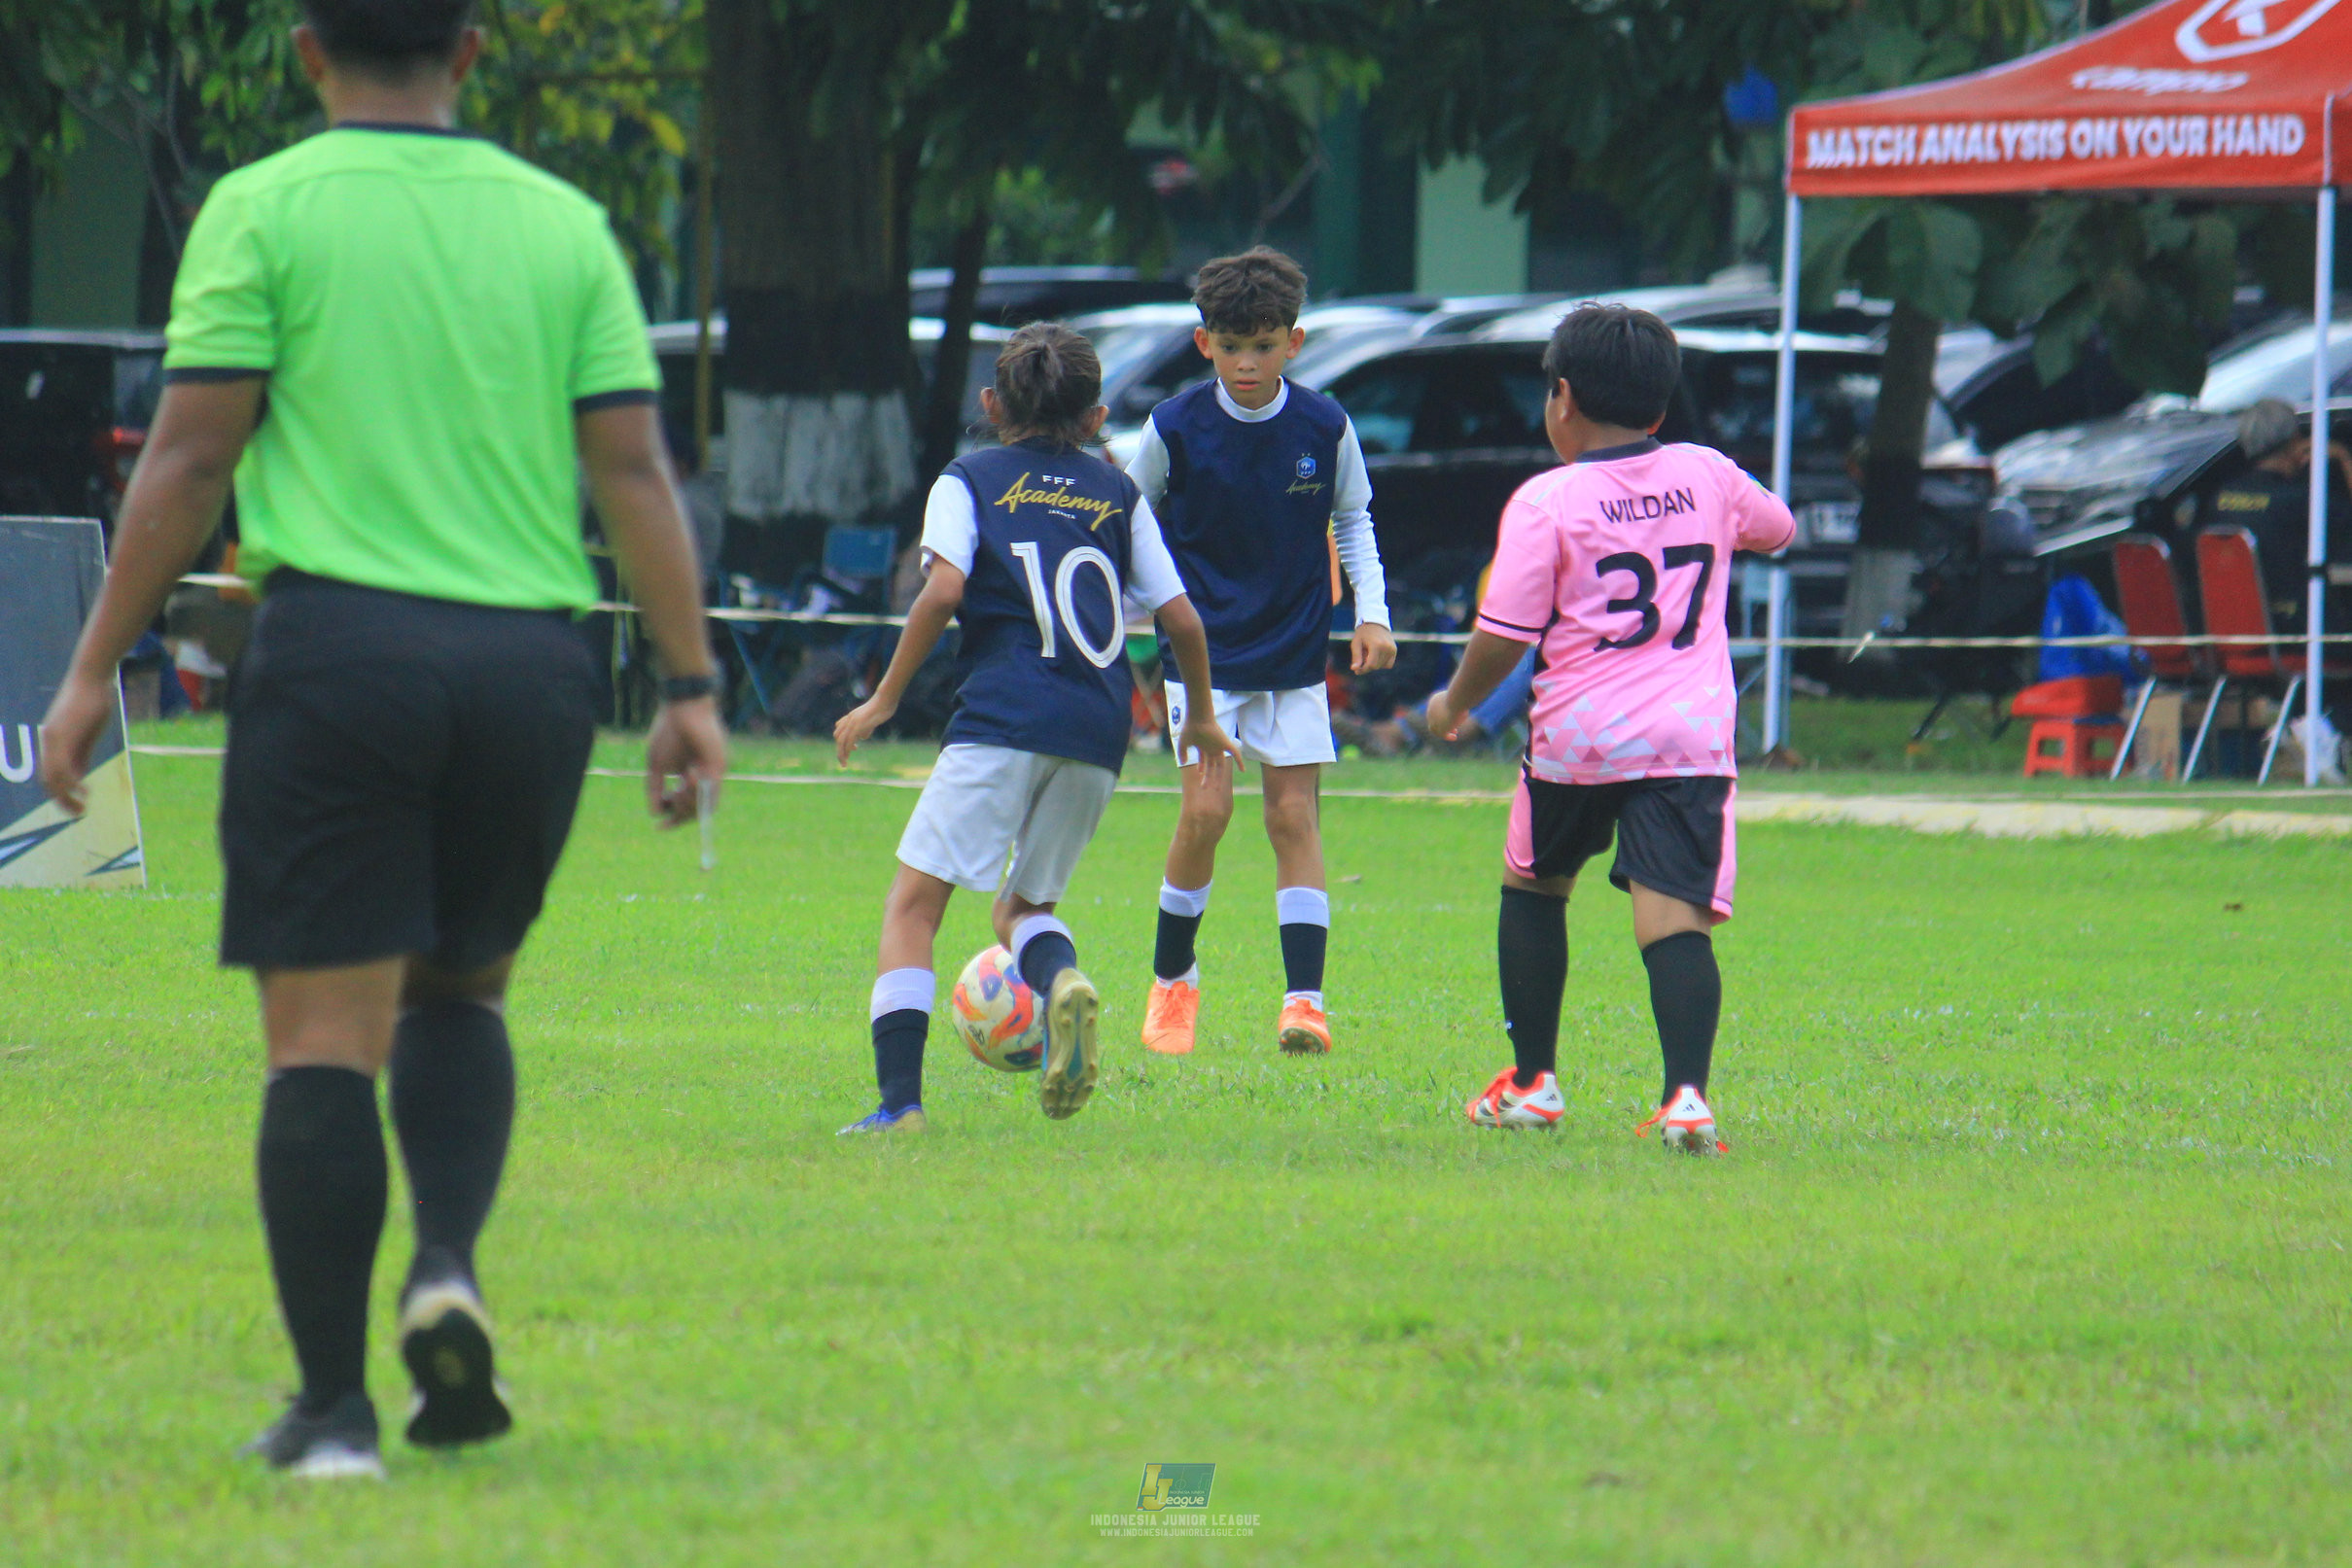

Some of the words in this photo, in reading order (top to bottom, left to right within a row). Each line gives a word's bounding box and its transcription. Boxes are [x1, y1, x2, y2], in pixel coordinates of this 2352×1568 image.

[1807, 125, 1918, 169] MATCH
[1917, 119, 2067, 165] ANALYSIS
[2069, 116, 2121, 160] ON
[2123, 114, 2209, 158] YOUR
[2211, 112, 2307, 157] HAND
[994, 471, 1123, 532] Academy
[1041, 474, 1076, 486] FFF
[1598, 487, 1697, 523] WILDAN
[1009, 540, 1124, 669] 10
[1593, 542, 1716, 652] 37
